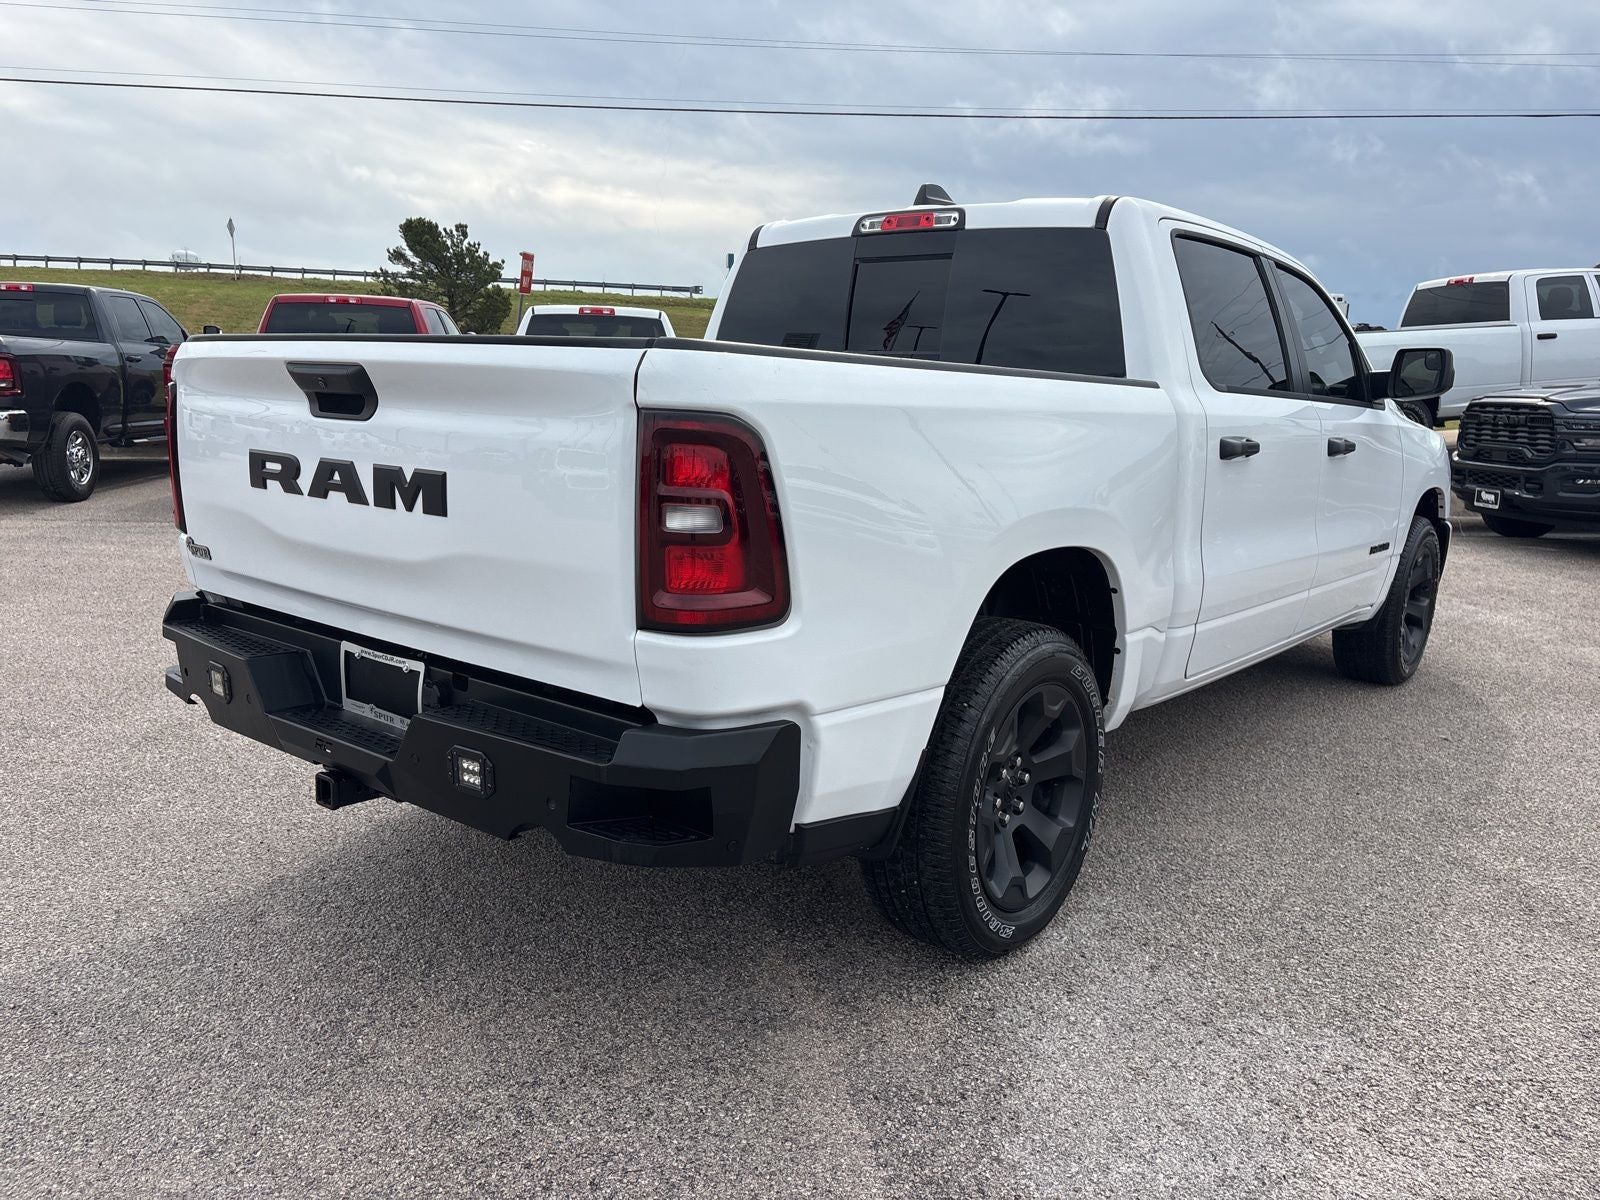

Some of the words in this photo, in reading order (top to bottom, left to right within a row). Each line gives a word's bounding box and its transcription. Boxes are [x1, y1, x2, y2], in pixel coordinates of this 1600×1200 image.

[1479, 414, 1527, 425] RAM
[248, 448, 448, 518] RAM
[190, 544, 210, 559] SPUR
[373, 710, 395, 725] SPUR
[1070, 664, 1105, 775] DUELER
[967, 726, 1016, 939] BRIDGESTONE
